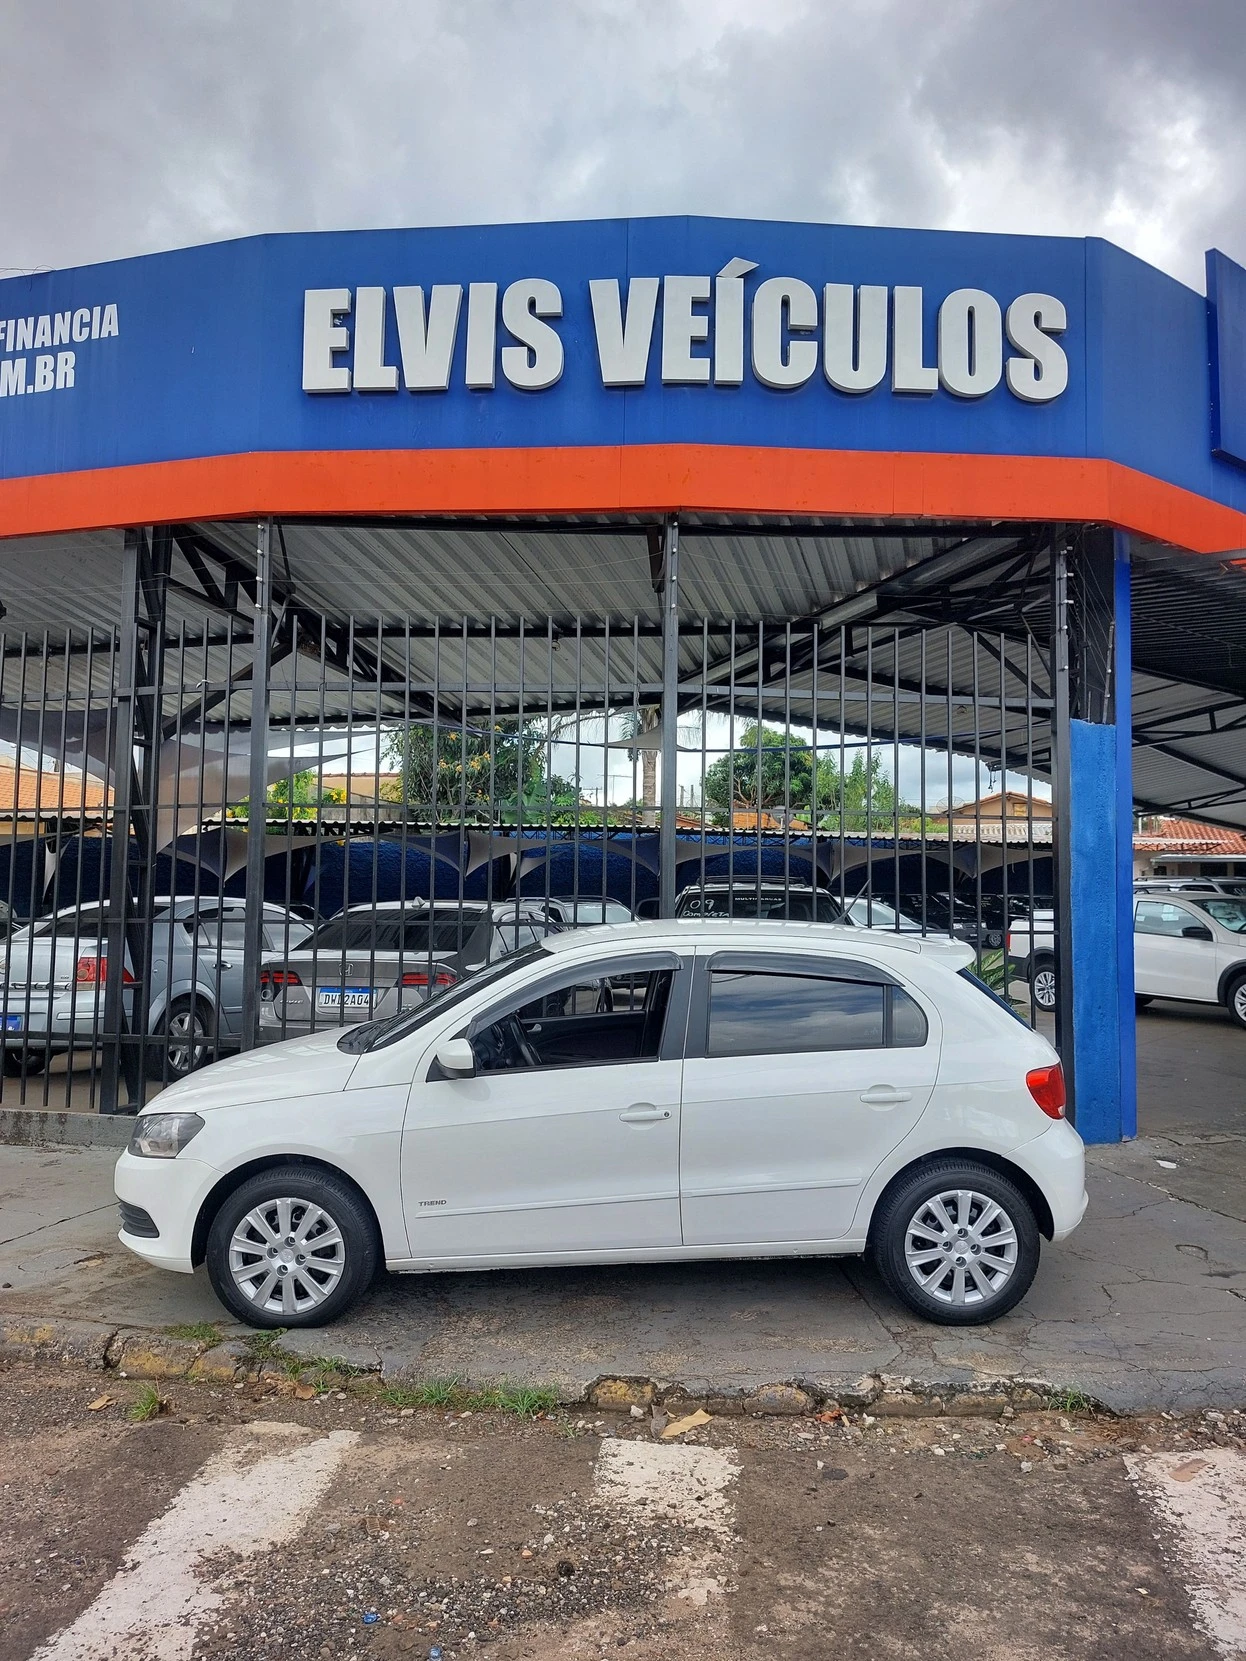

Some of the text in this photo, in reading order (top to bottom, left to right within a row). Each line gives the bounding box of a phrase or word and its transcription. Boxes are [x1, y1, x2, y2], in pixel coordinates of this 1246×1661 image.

[302, 257, 1069, 402] ELVIS VEÍCULOS
[690, 899, 714, 910] 09
